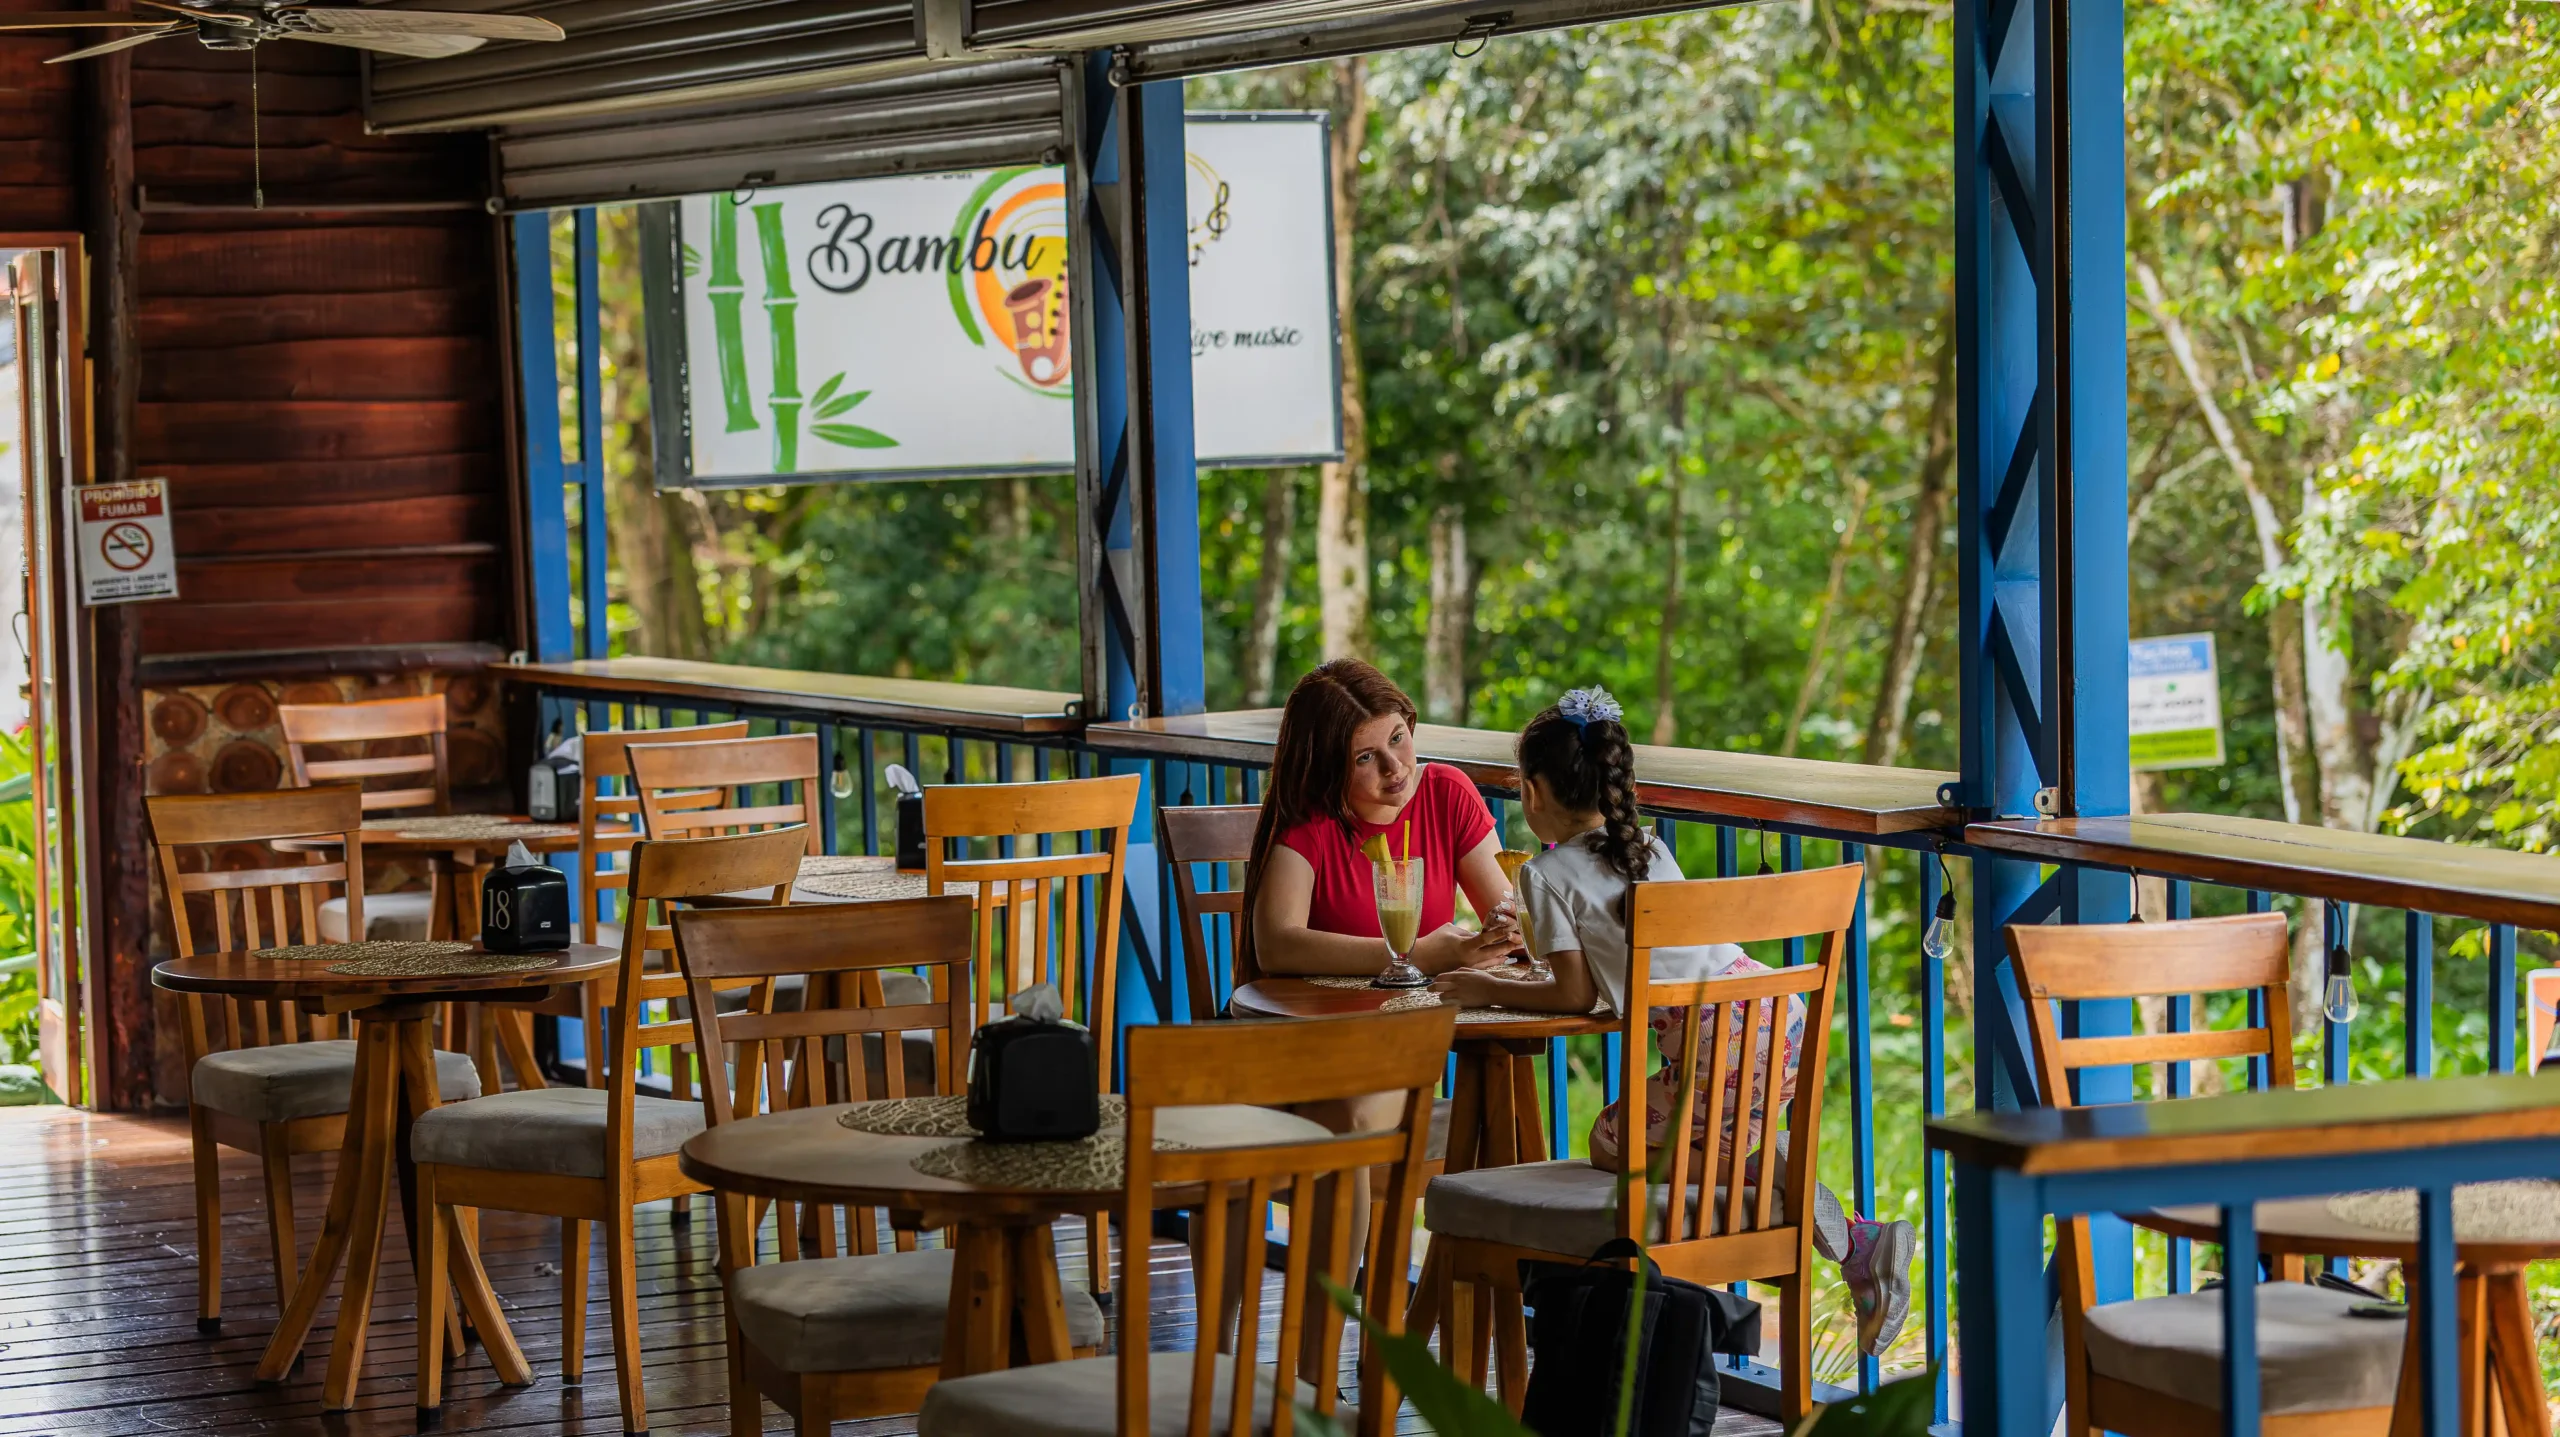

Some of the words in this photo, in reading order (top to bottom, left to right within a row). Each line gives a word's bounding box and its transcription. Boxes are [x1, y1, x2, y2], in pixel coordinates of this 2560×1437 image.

[808, 203, 1045, 293] Bambu
[1234, 326, 1303, 347] music
[84, 483, 161, 503] PROHIBIDO
[98, 501, 147, 517] FUMAR
[487, 888, 510, 930] 18
